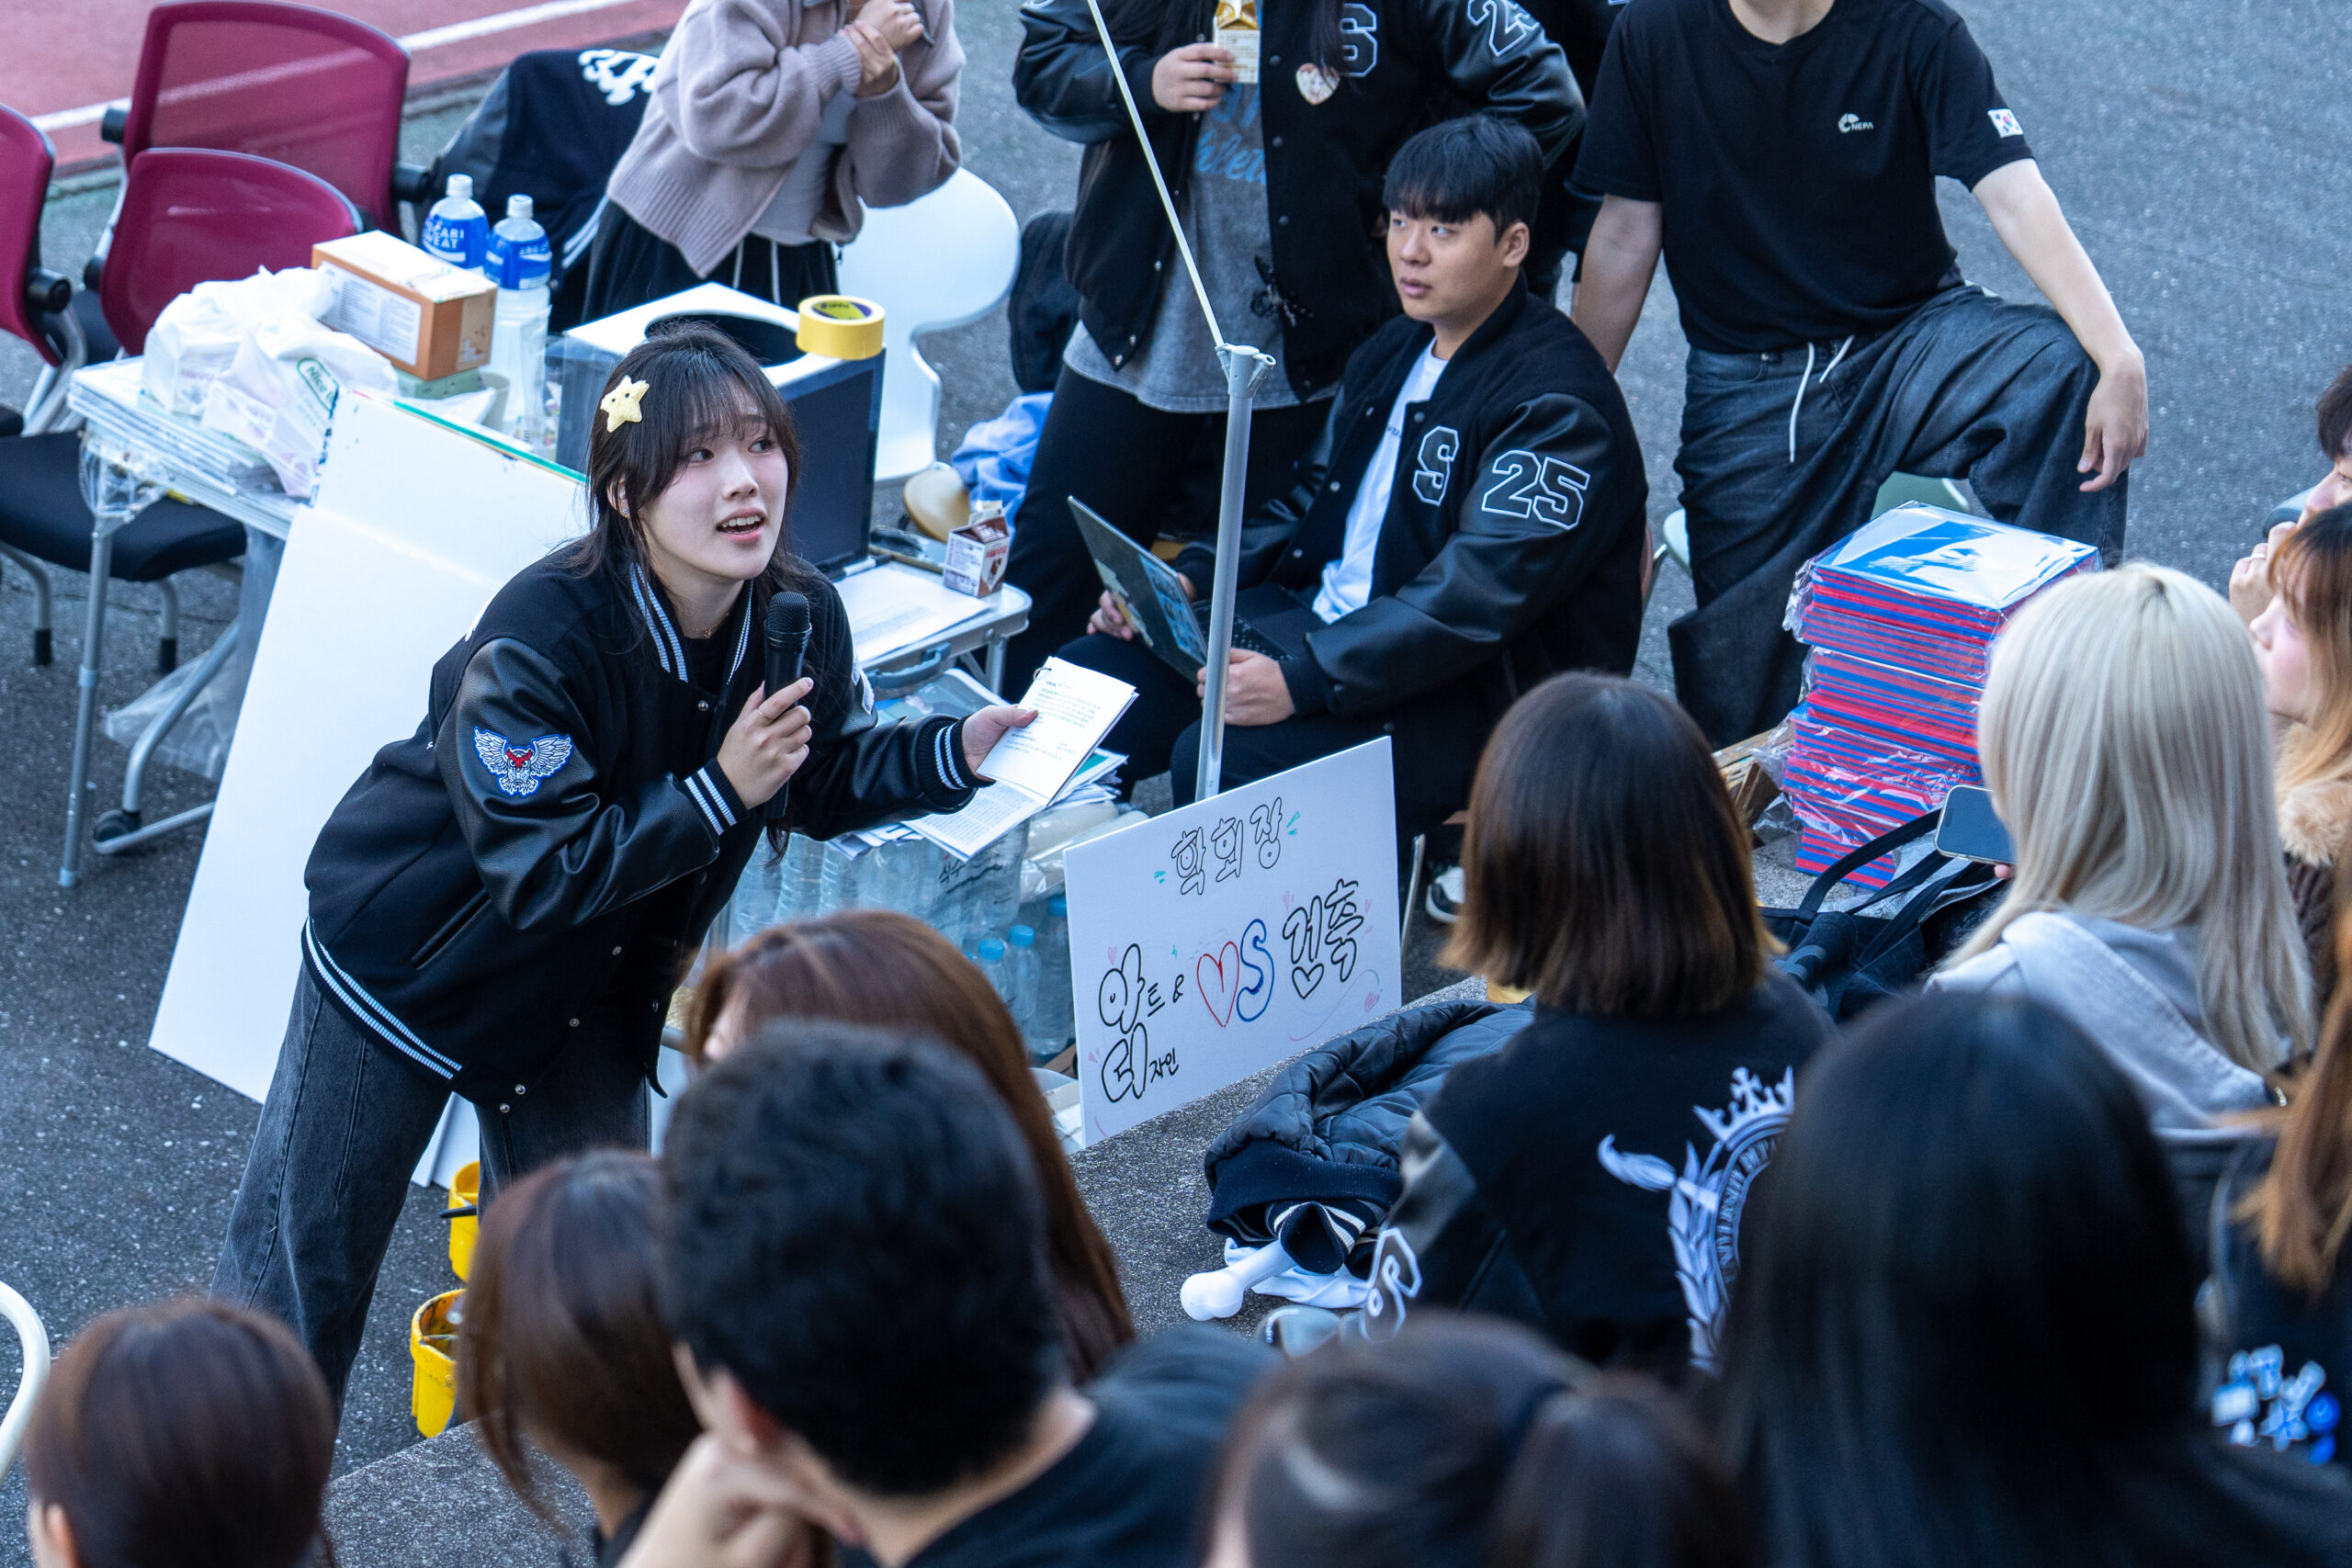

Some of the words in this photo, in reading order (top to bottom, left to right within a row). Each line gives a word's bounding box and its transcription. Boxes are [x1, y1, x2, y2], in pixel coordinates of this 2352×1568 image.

[1467, 0, 1540, 57] 2
[1851, 121, 1873, 131] NEPA
[1412, 425, 1459, 507] S
[1481, 449, 1591, 531] 25
[1170, 796, 1283, 896] 학회장
[1283, 877, 1365, 999] 건축
